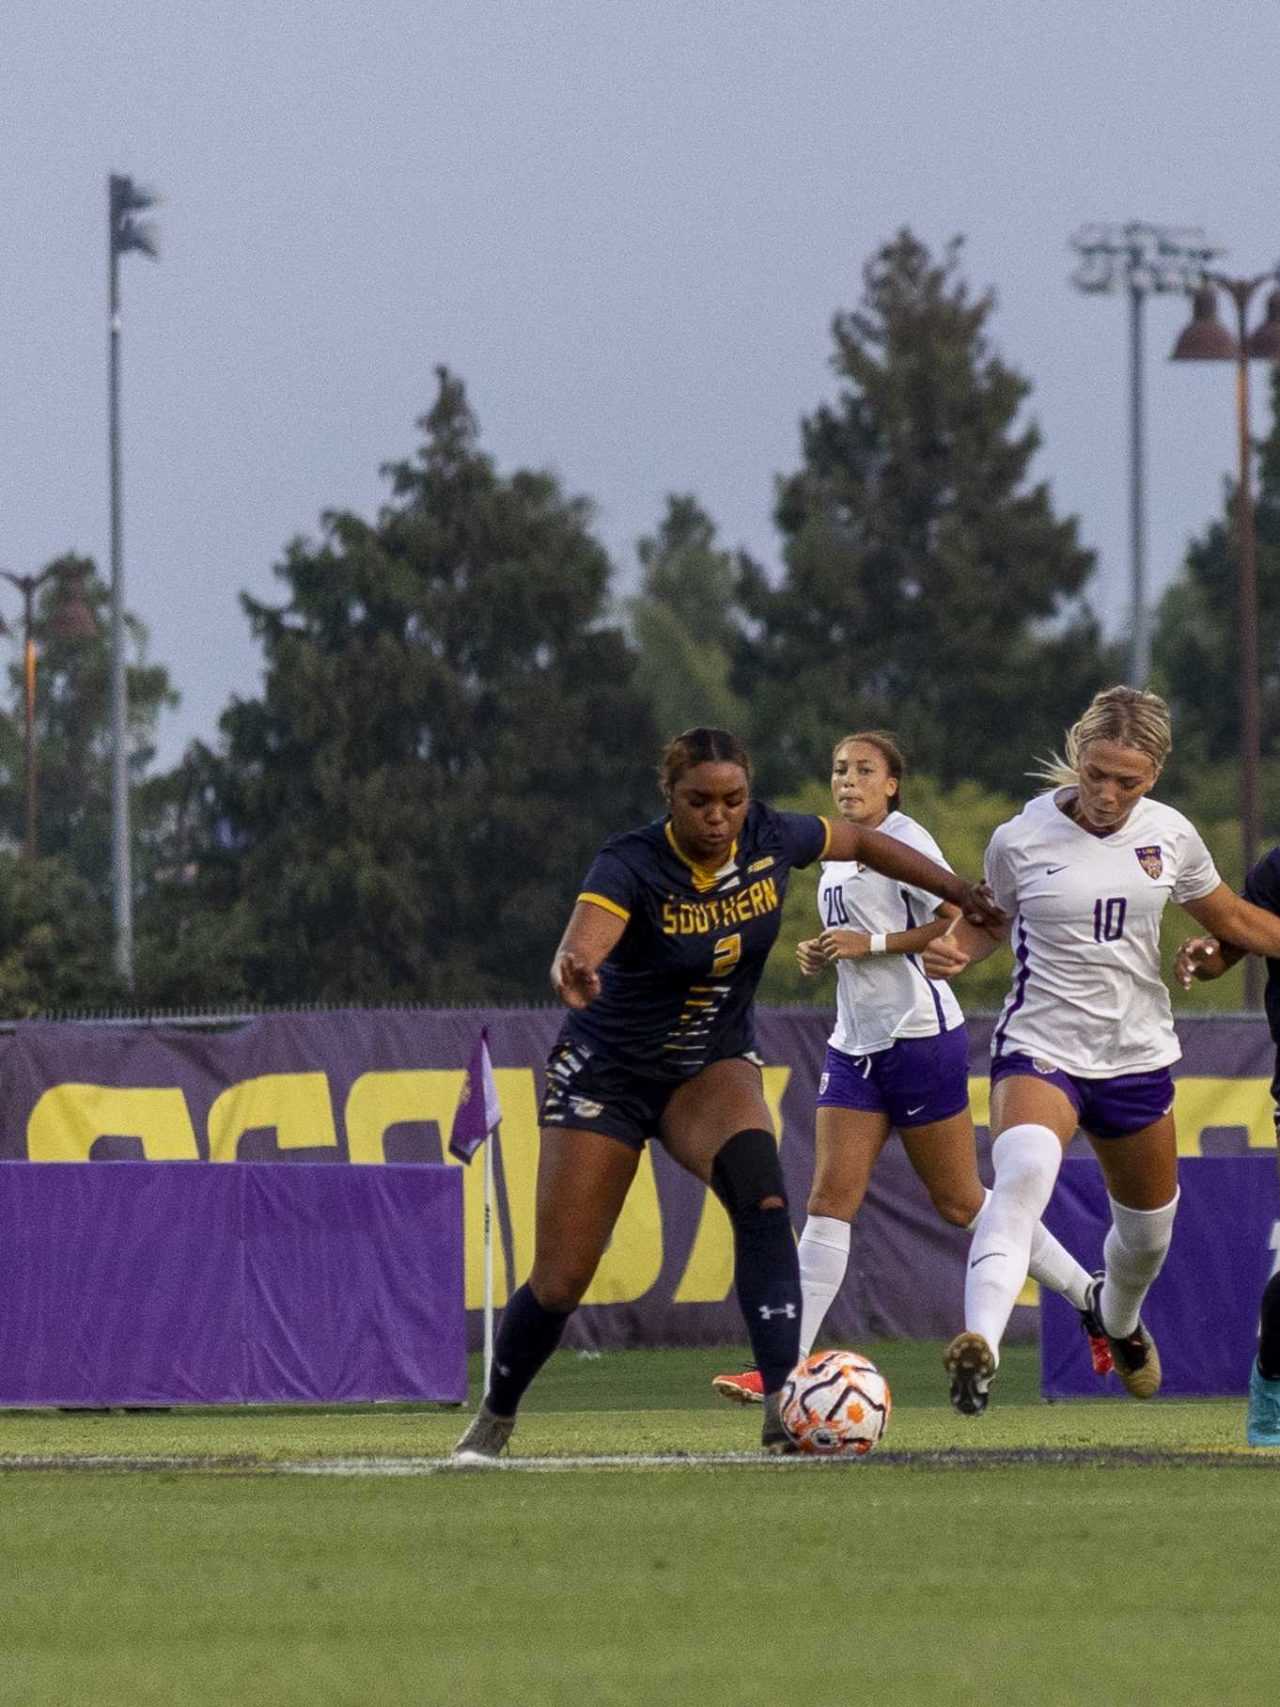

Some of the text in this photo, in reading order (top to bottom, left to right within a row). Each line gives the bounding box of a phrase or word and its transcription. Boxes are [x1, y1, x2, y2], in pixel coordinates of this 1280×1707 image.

[662, 877, 778, 935] SOUTHERN
[823, 885, 850, 928] 20
[1093, 897, 1127, 943] 10
[710, 933, 742, 977] 2
